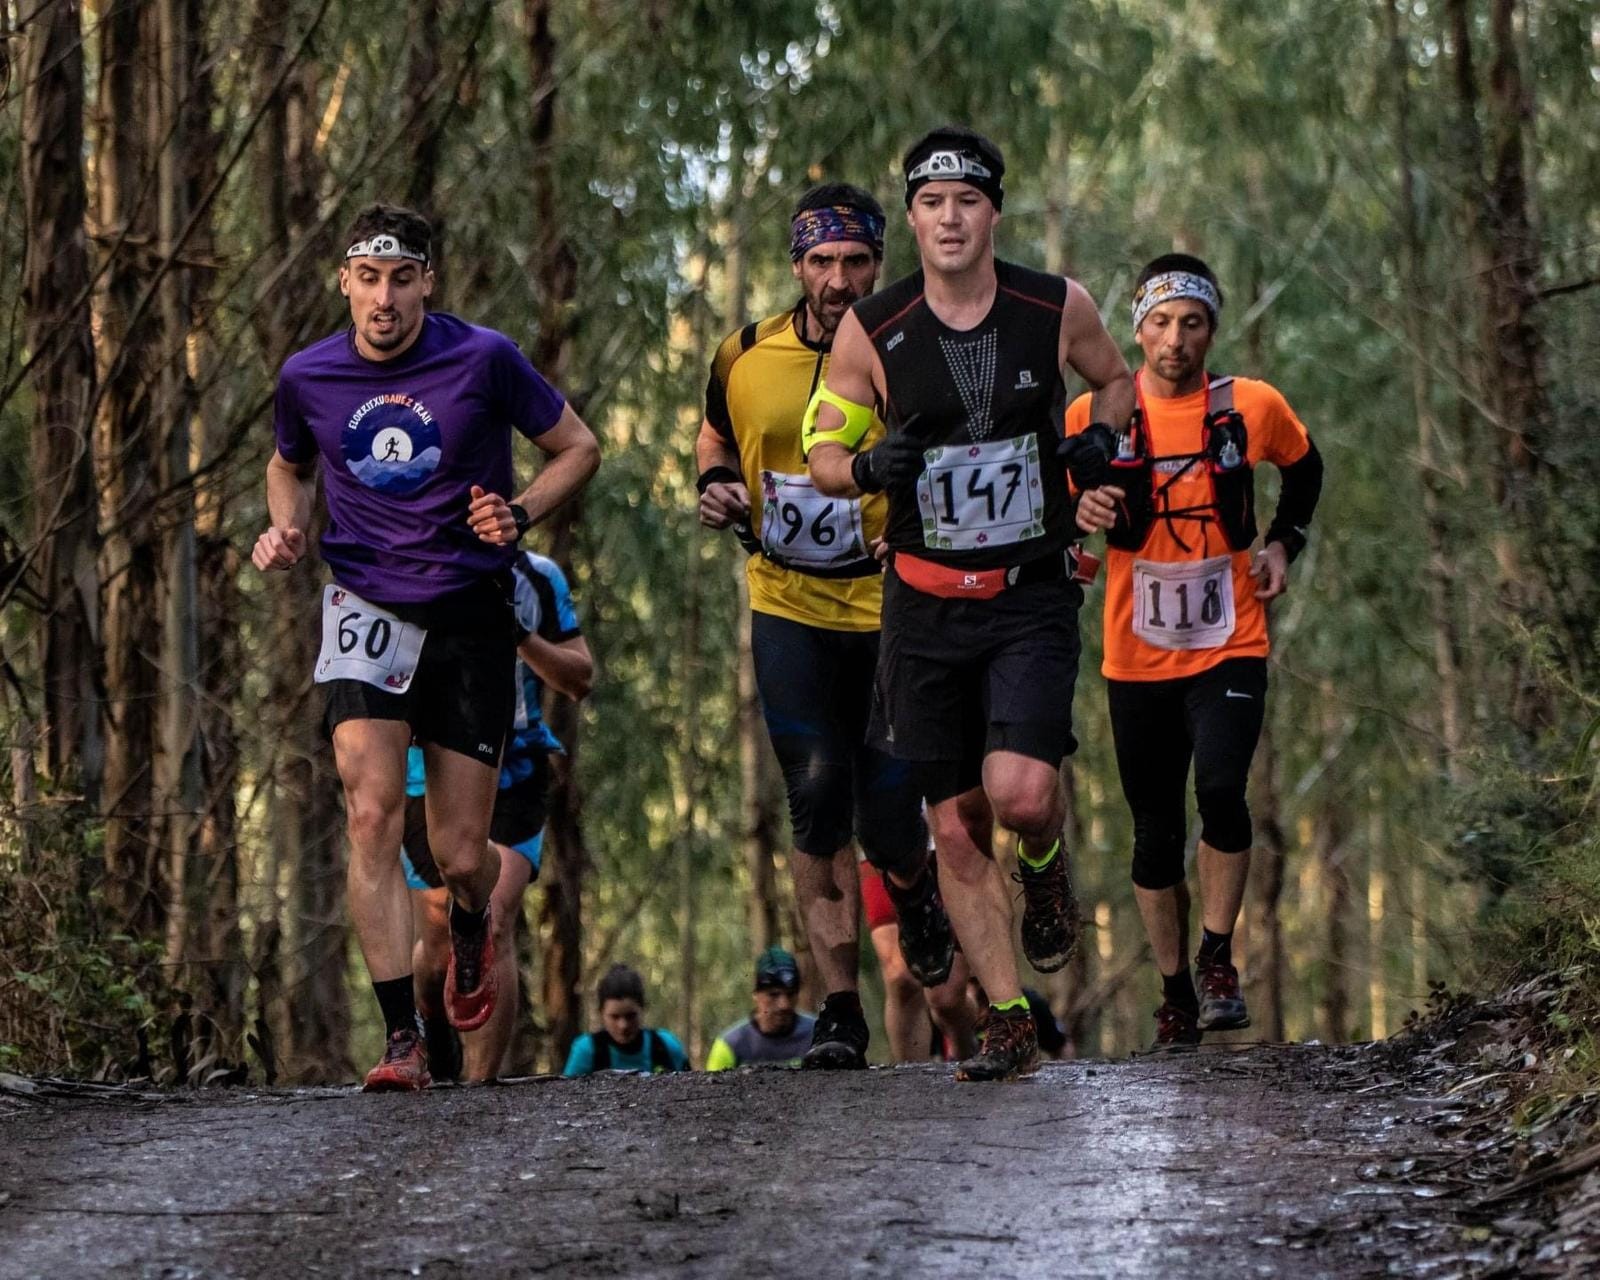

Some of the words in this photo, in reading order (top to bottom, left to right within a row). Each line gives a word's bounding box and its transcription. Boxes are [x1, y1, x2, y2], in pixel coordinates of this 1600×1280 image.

[412, 400, 432, 426] TRAIL
[936, 462, 1023, 526] 147
[782, 502, 836, 546] 96
[1149, 579, 1222, 630] 118
[338, 612, 391, 660] 60
